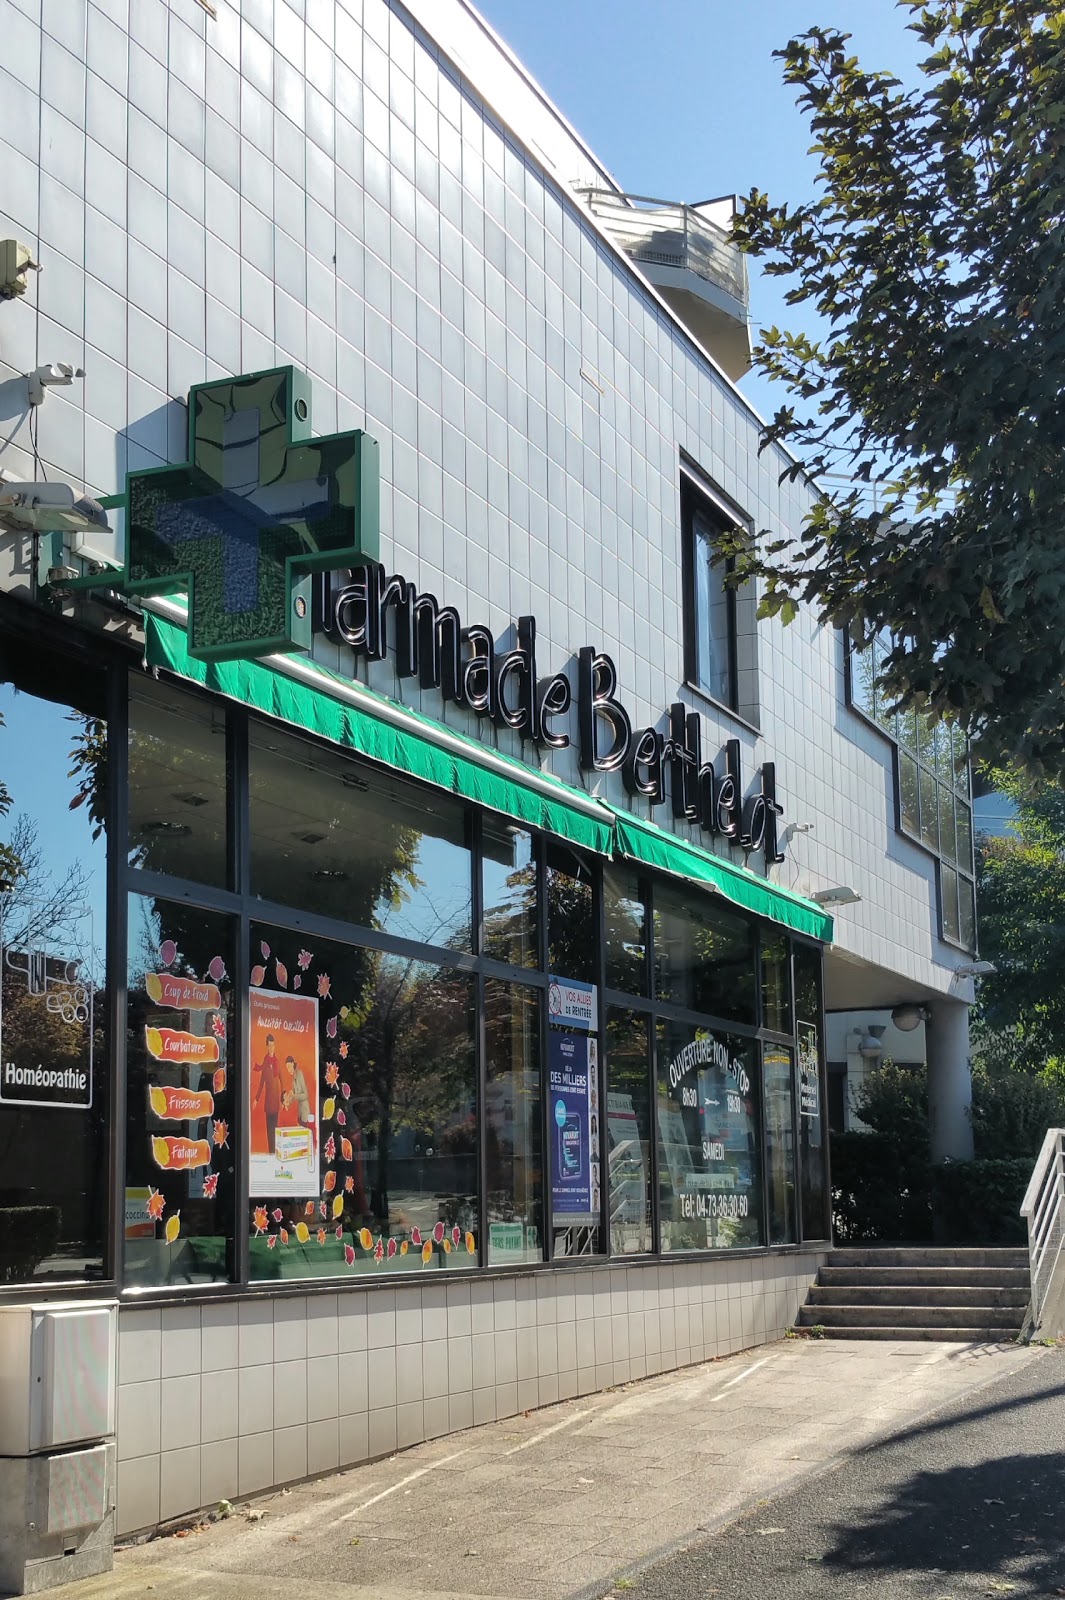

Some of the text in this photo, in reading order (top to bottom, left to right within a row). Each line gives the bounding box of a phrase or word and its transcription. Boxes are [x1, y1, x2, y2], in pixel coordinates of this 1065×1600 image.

[580, 646, 785, 865] Berthelot
[164, 983, 209, 1005] Coup de froid
[565, 990, 592, 1006] VOS ALLIÉS
[565, 1006, 592, 1019] DE RENTRÉE
[164, 1037, 206, 1054] Courbatures
[669, 1039, 713, 1088] OUVERTURE
[5, 1062, 87, 1090] Homéopathie
[550, 1071, 587, 1087] DES MILLIERS
[169, 1095, 201, 1110] Frissons
[682, 1086, 740, 1114] 8h30 19h30
[172, 1145, 198, 1167] Fatigue
[702, 1141, 725, 1160] SAMEDI
